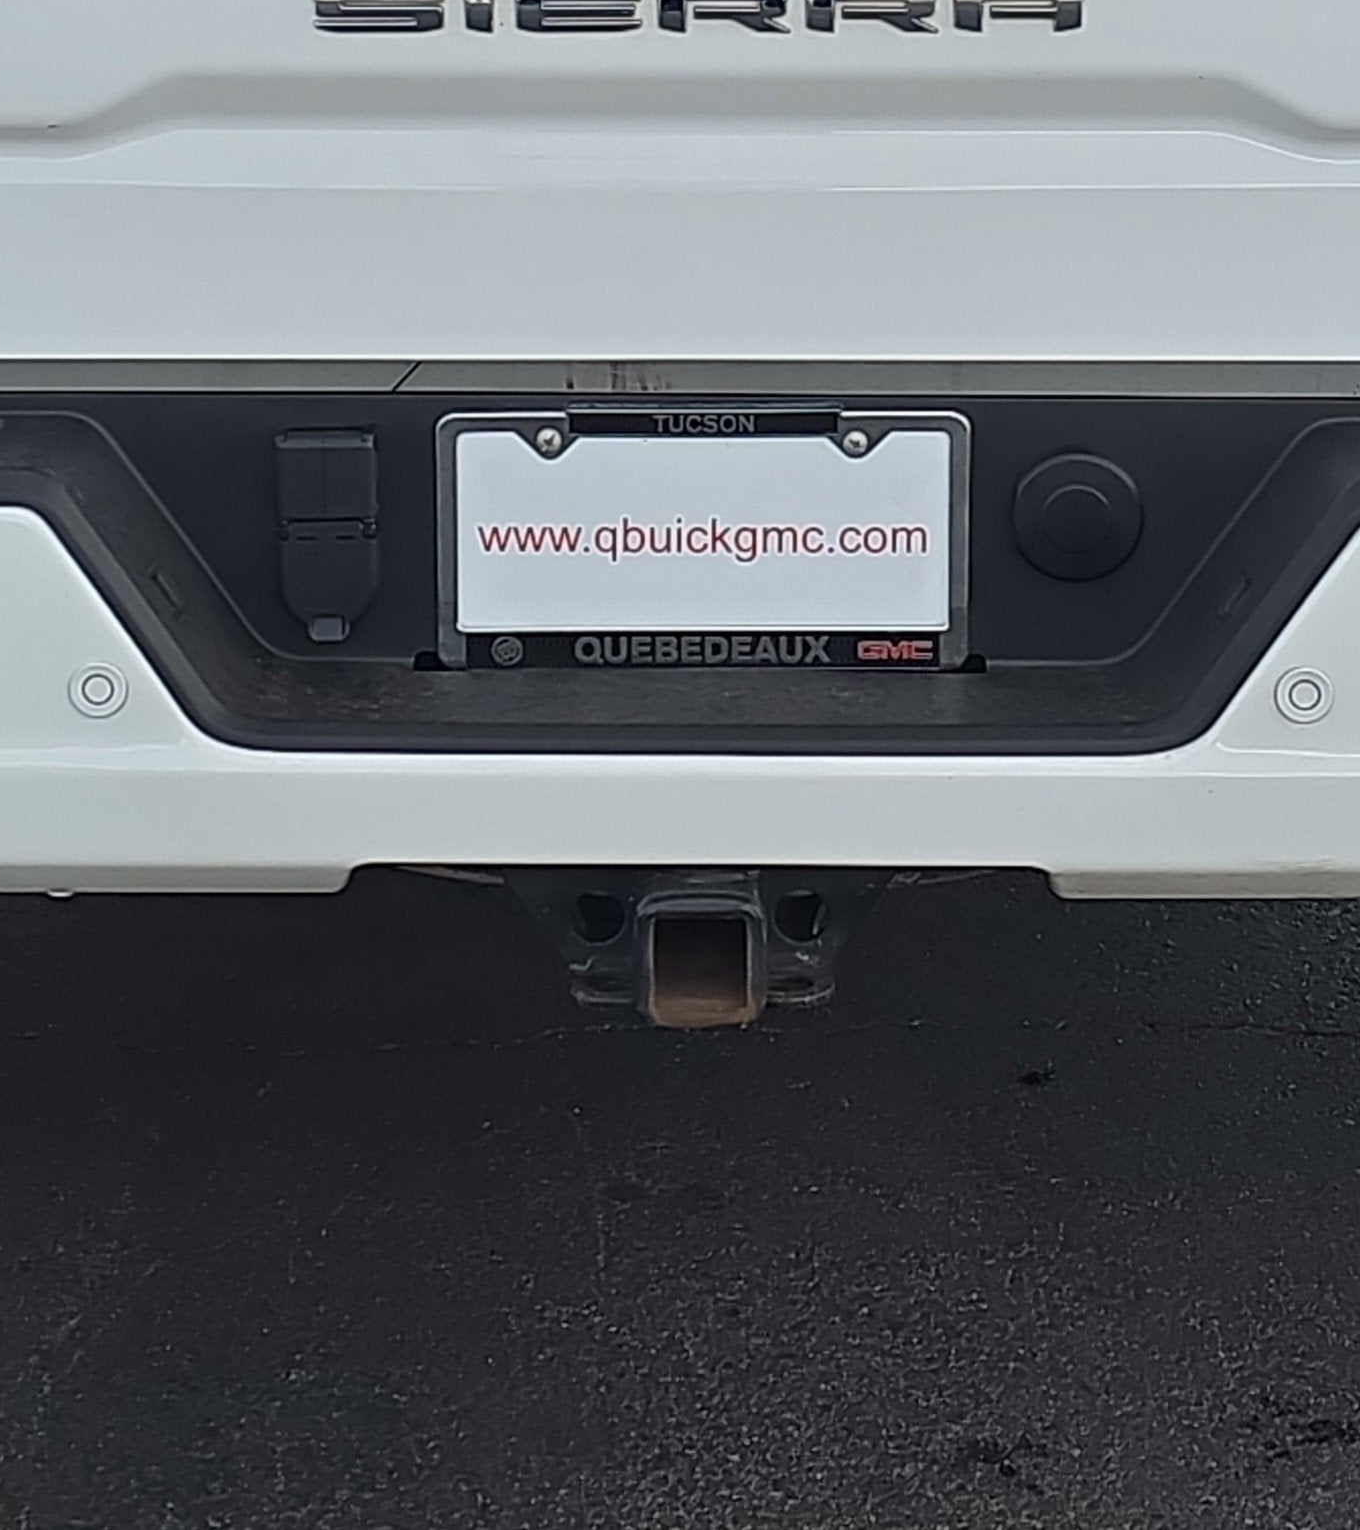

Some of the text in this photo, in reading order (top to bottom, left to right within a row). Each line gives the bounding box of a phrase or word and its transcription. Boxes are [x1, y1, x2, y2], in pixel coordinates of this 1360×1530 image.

[653, 415, 755, 434] TUCSON
[477, 518, 928, 562] www.qbuickgmc.com
[574, 635, 933, 664] QUEBEDEAUX GMC
